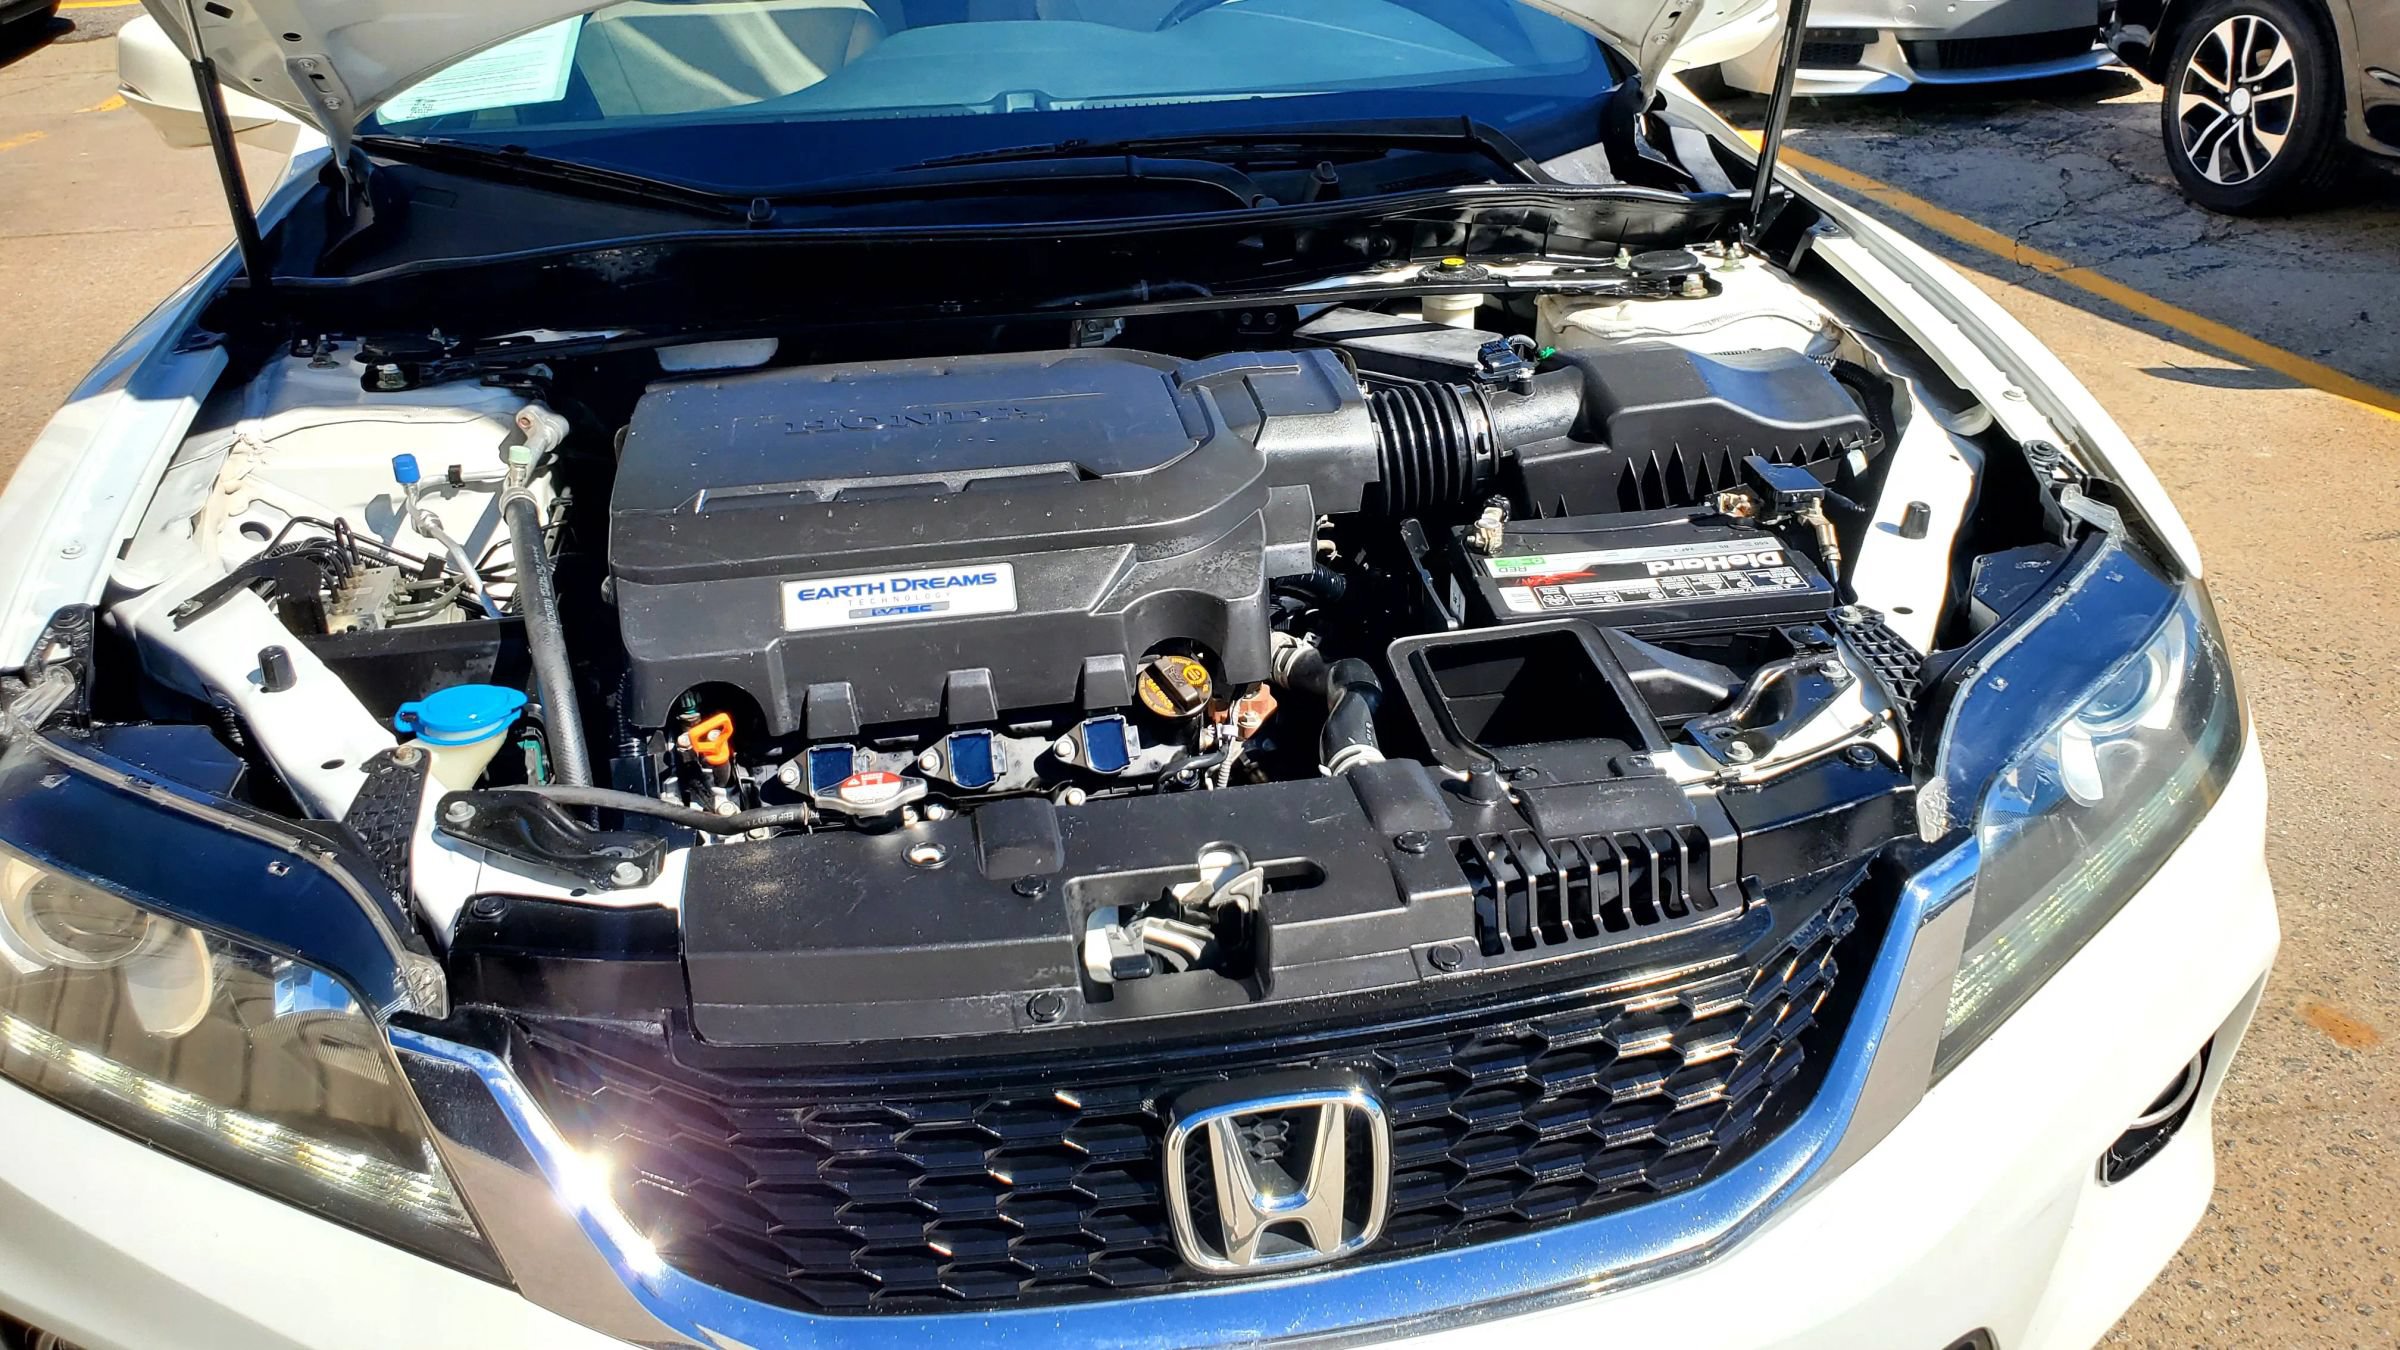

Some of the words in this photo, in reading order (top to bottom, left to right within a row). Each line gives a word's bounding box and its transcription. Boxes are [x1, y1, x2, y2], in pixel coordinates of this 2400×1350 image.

[1646, 551, 1783, 576] DieHard
[797, 581, 885, 601] EARTH
[891, 572, 997, 593] DREAMS
[849, 591, 950, 607] TECHNOLOGY
